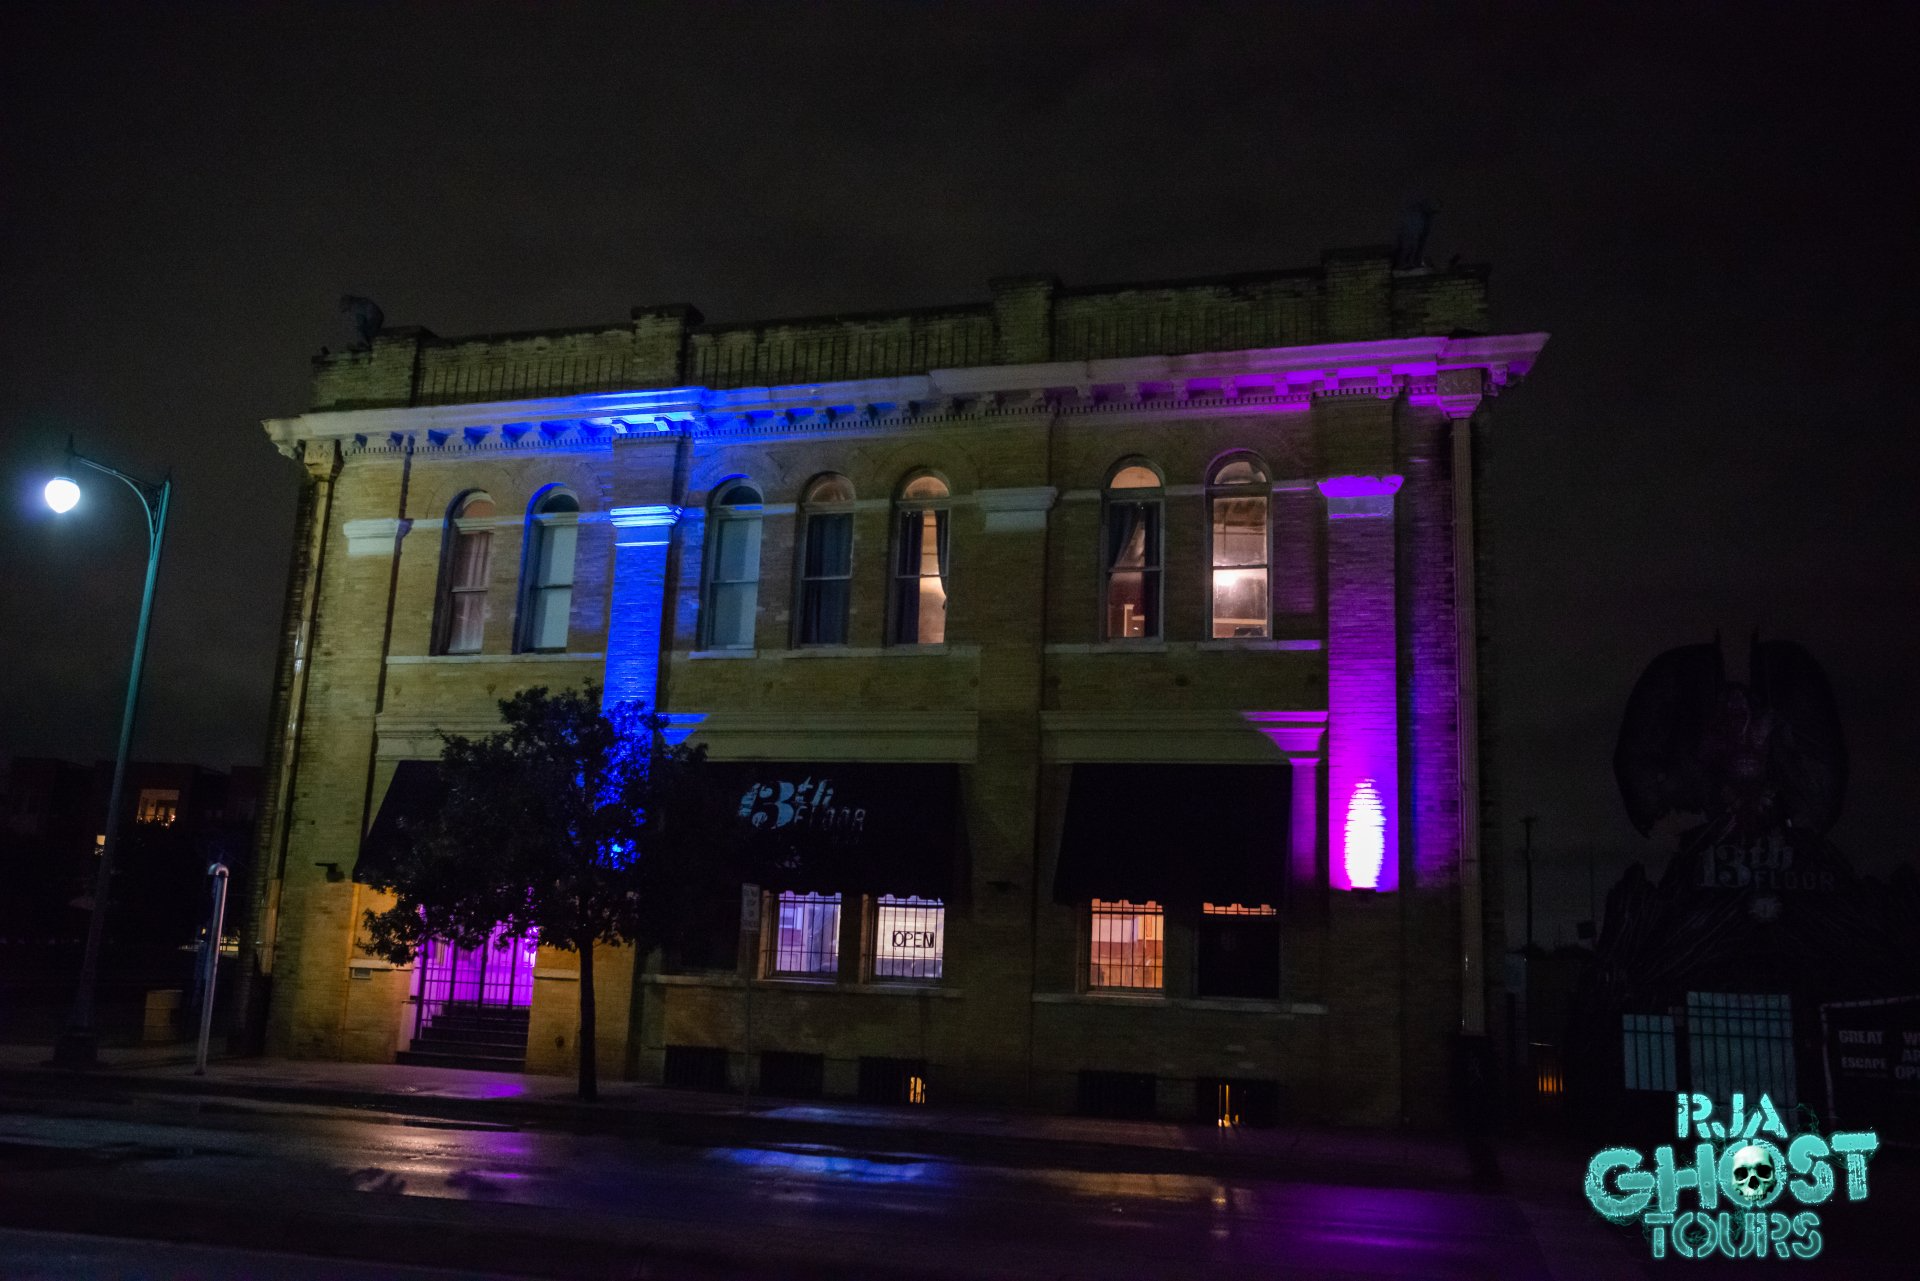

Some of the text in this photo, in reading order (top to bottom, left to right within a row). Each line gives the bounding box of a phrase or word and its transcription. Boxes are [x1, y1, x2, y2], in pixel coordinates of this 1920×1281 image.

[1697, 836, 1794, 888] 13th
[1754, 870, 1834, 891] FLOOR
[893, 931, 934, 948] OPEN
[1838, 1030, 1883, 1044] GREAT
[1841, 1056, 1887, 1069] ESCAPE
